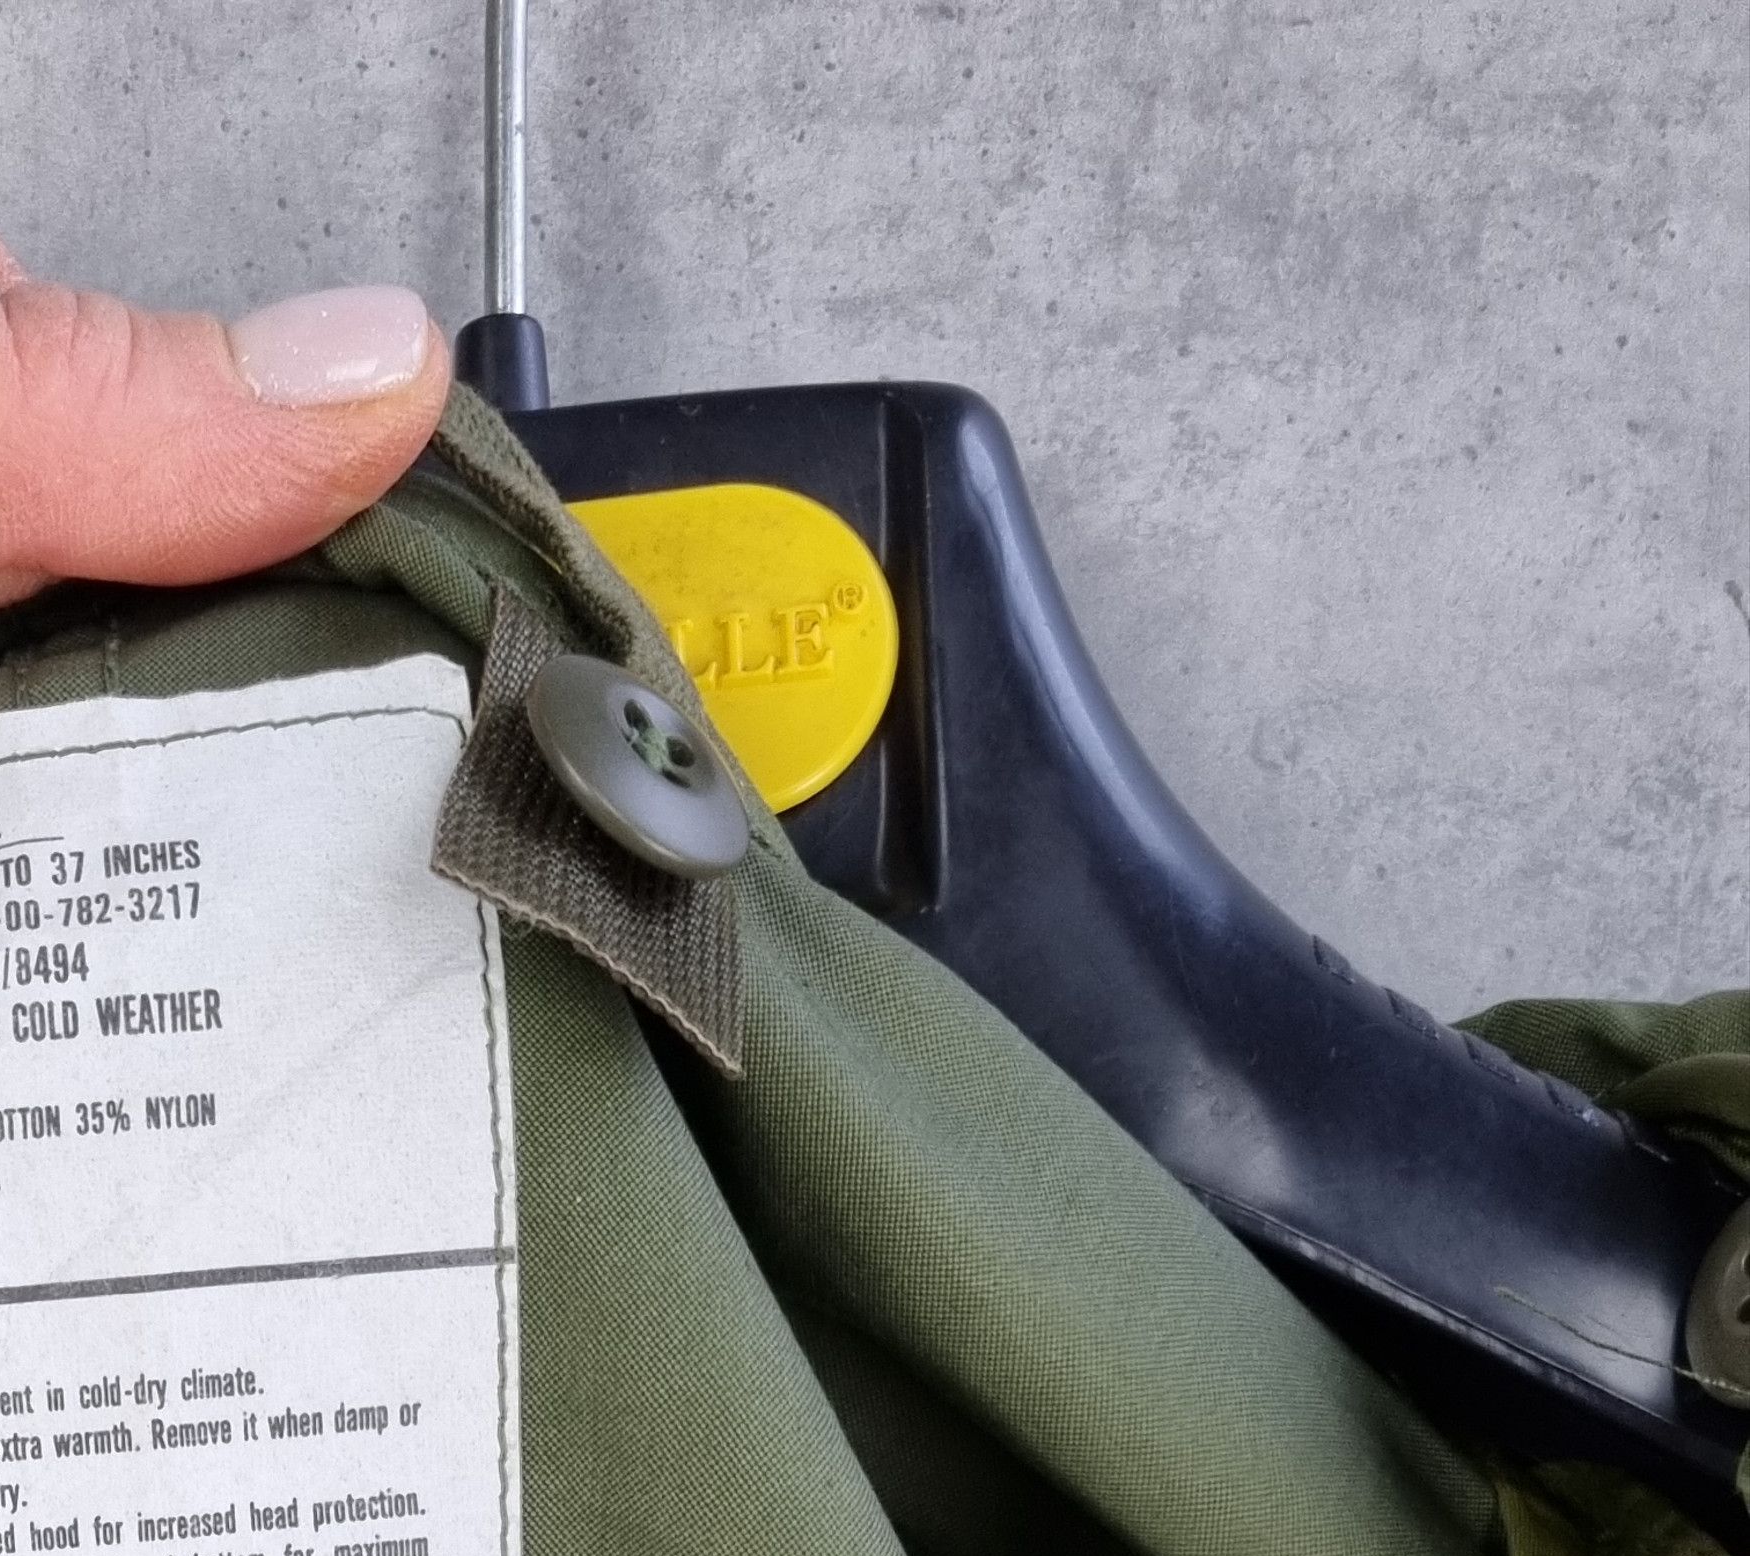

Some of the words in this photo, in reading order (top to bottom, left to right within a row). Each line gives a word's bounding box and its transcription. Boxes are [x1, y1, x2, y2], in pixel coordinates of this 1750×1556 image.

[50, 850, 85, 886] 37
[103, 839, 201, 879] INCHES
[11, 1000, 79, 1043] COLD
[95, 988, 223, 1037] WEATHER
[75, 1098, 131, 1136] 35%
[145, 1092, 216, 1130] NYLON
[45, 1380, 65, 1412] in
[78, 1372, 167, 1410] cold-dry
[180, 1366, 265, 1401] climate.
[29, 1517, 80, 1552] hood
[92, 1515, 124, 1547] for
[136, 1502, 237, 1543] increased
[249, 1497, 299, 1532] head
[312, 1487, 426, 1533] protection.
